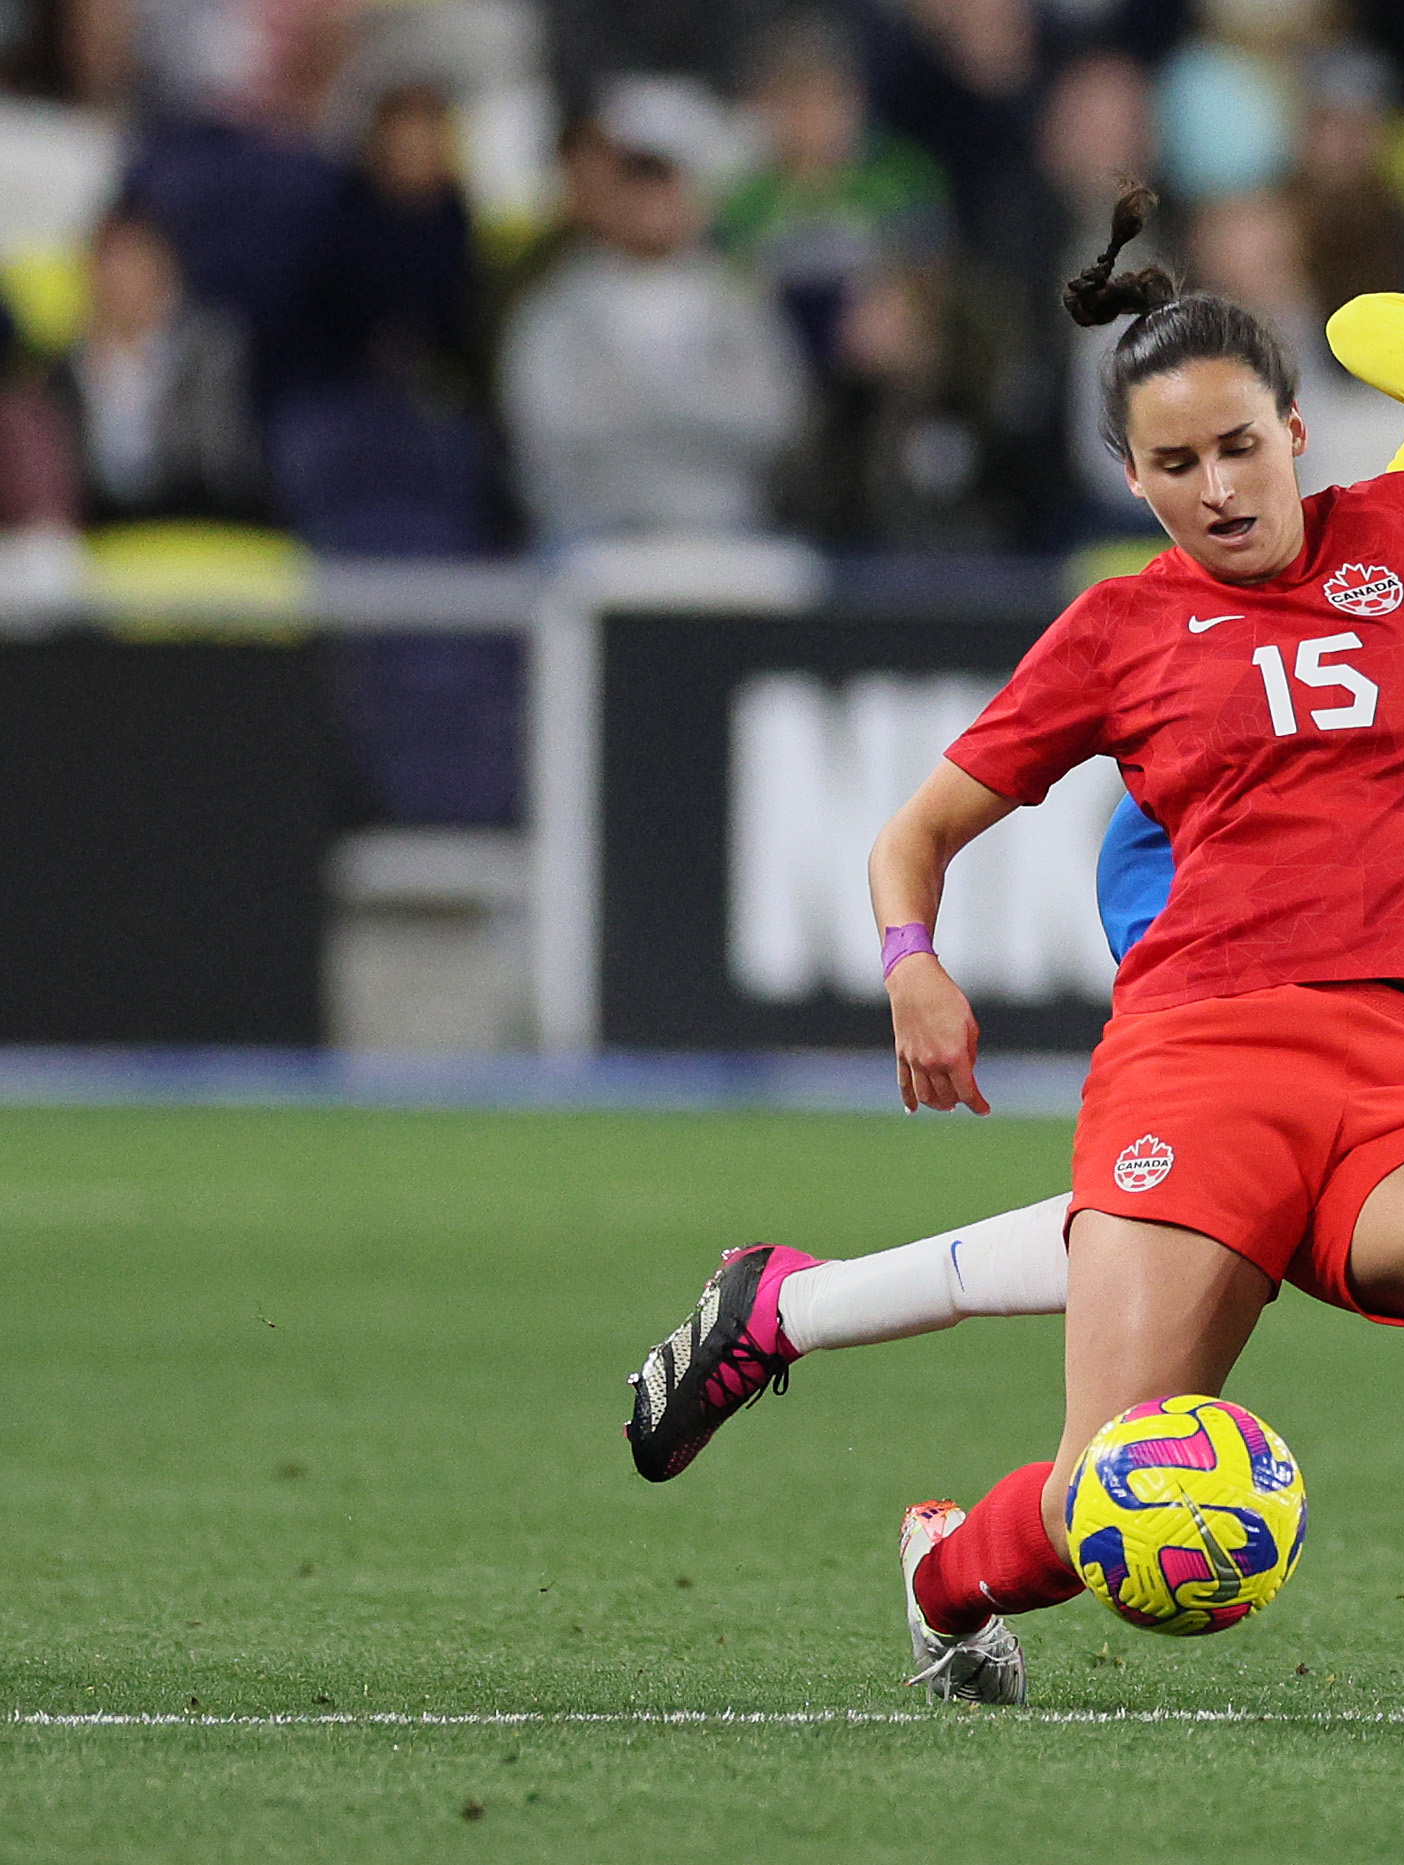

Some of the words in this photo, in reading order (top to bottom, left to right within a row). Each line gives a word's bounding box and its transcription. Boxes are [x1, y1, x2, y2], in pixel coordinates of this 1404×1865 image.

[1331, 579, 1399, 603] CANADA
[1252, 631, 1379, 737] 15
[1117, 1159, 1169, 1172] CANADA
